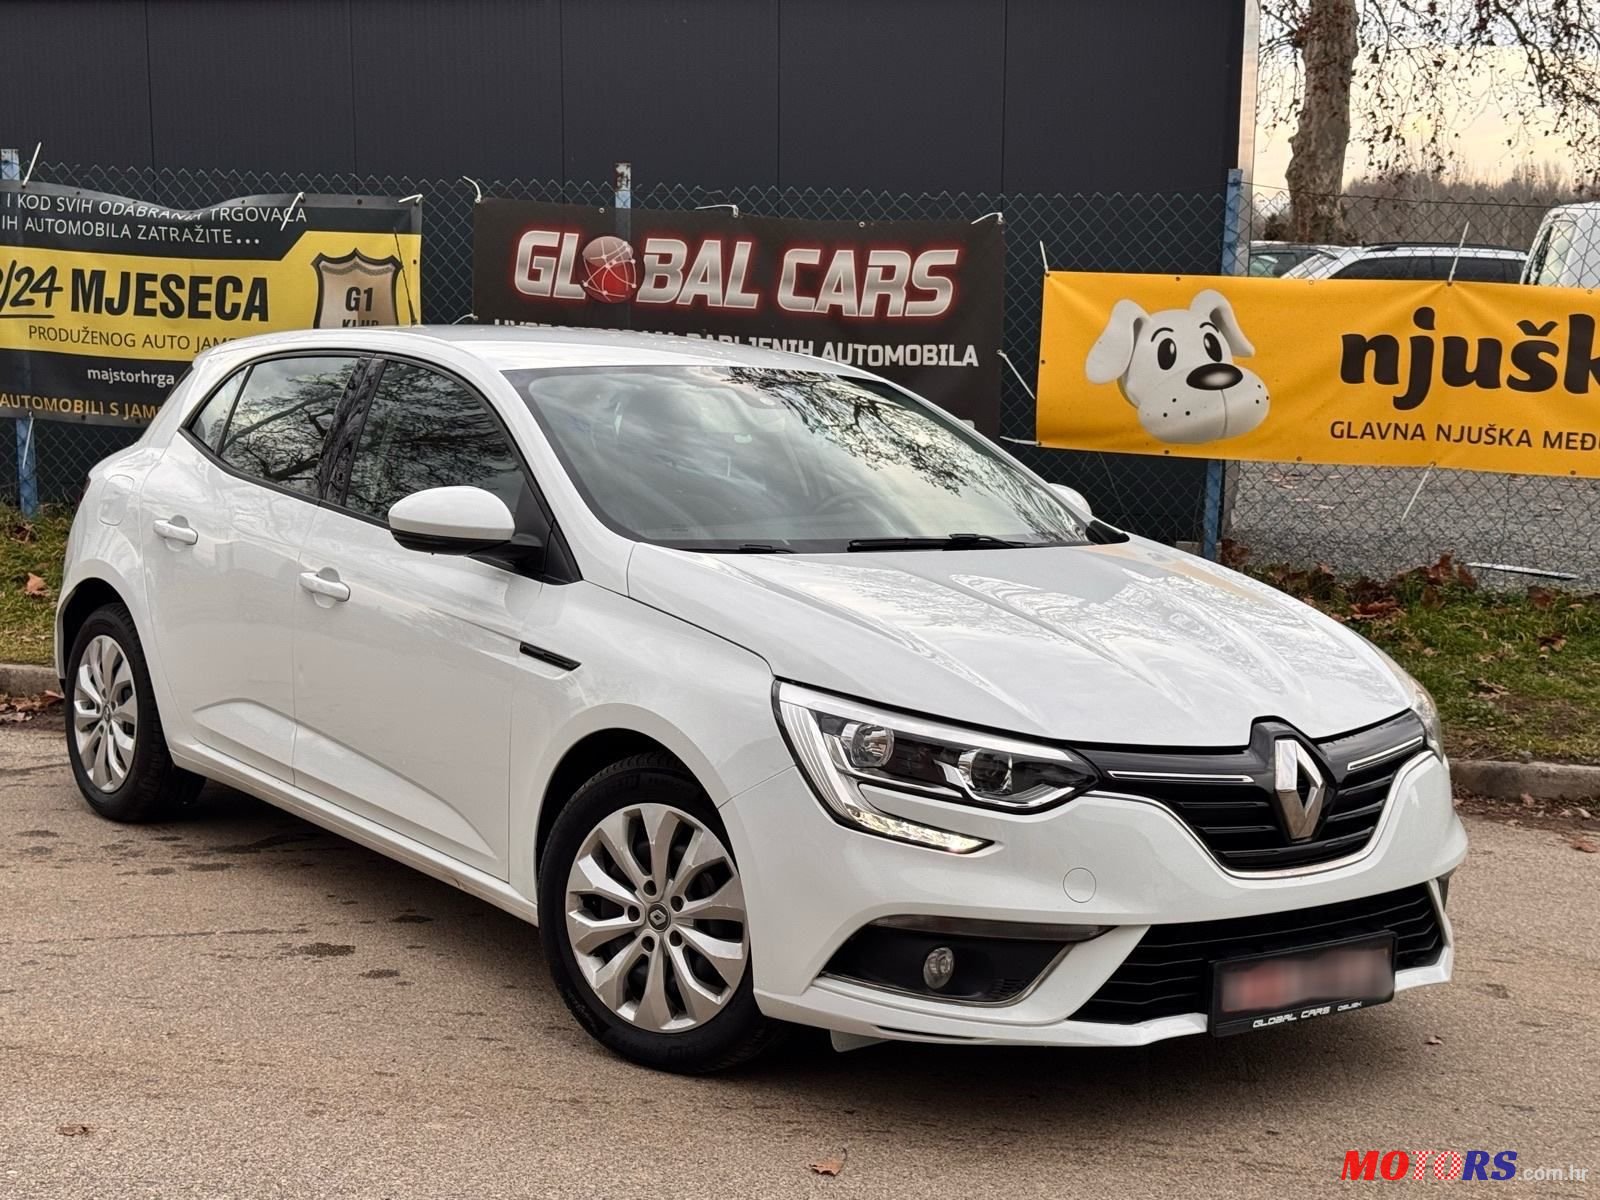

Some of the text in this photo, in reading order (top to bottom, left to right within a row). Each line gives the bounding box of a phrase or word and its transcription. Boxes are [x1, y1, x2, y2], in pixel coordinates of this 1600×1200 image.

[17, 194, 51, 211] KOD
[57, 197, 93, 214] SVIH
[25, 217, 132, 239] AUTOMOBILA
[71, 268, 269, 321] MJESECA
[777, 248, 959, 317] CARS
[345, 287, 373, 312] G1
[29, 325, 136, 347] PRODUŽENOG
[142, 333, 190, 350] AUTO
[821, 341, 979, 367] AUTOMOBILA
[87, 368, 175, 388] majstorhrga
[0, 393, 162, 421] AUTOMOBILI S JAM
[1330, 421, 1426, 441] GLAVNA
[1436, 424, 1533, 448] NJUŠKA
[1252, 1013, 1297, 1029] GLOBAL
[1300, 1005, 1331, 1019] CARS
